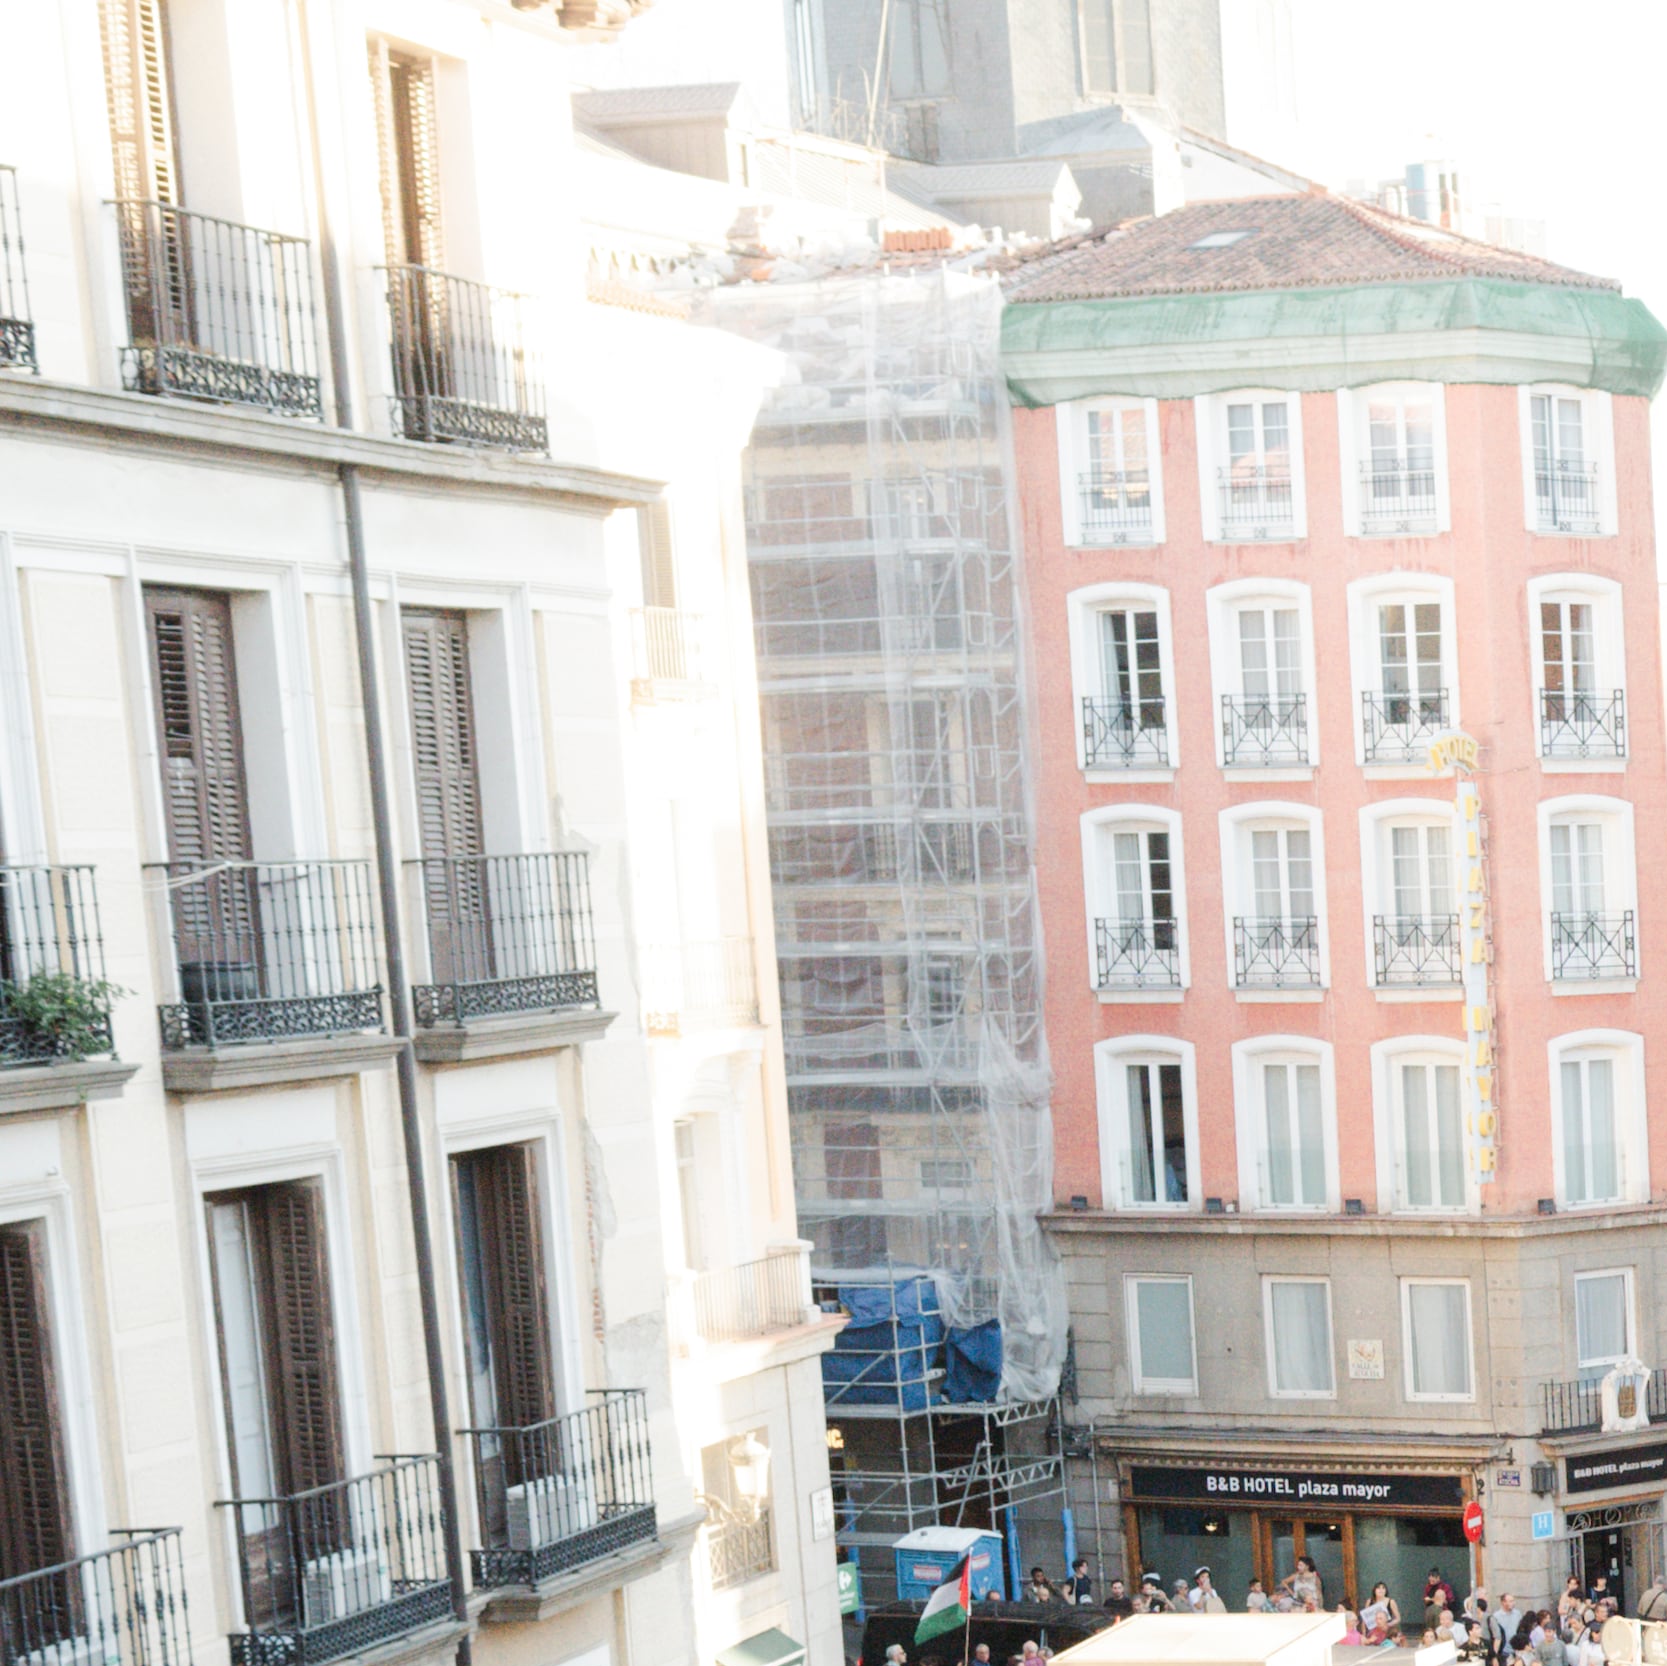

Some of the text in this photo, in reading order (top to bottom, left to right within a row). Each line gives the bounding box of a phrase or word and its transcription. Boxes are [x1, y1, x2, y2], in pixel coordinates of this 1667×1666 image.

[1430, 735, 1479, 770] HOTEL
[1593, 1463, 1619, 1478] HOTEL
[1207, 1475, 1391, 1500] B&B HOTEL plaza mayor
